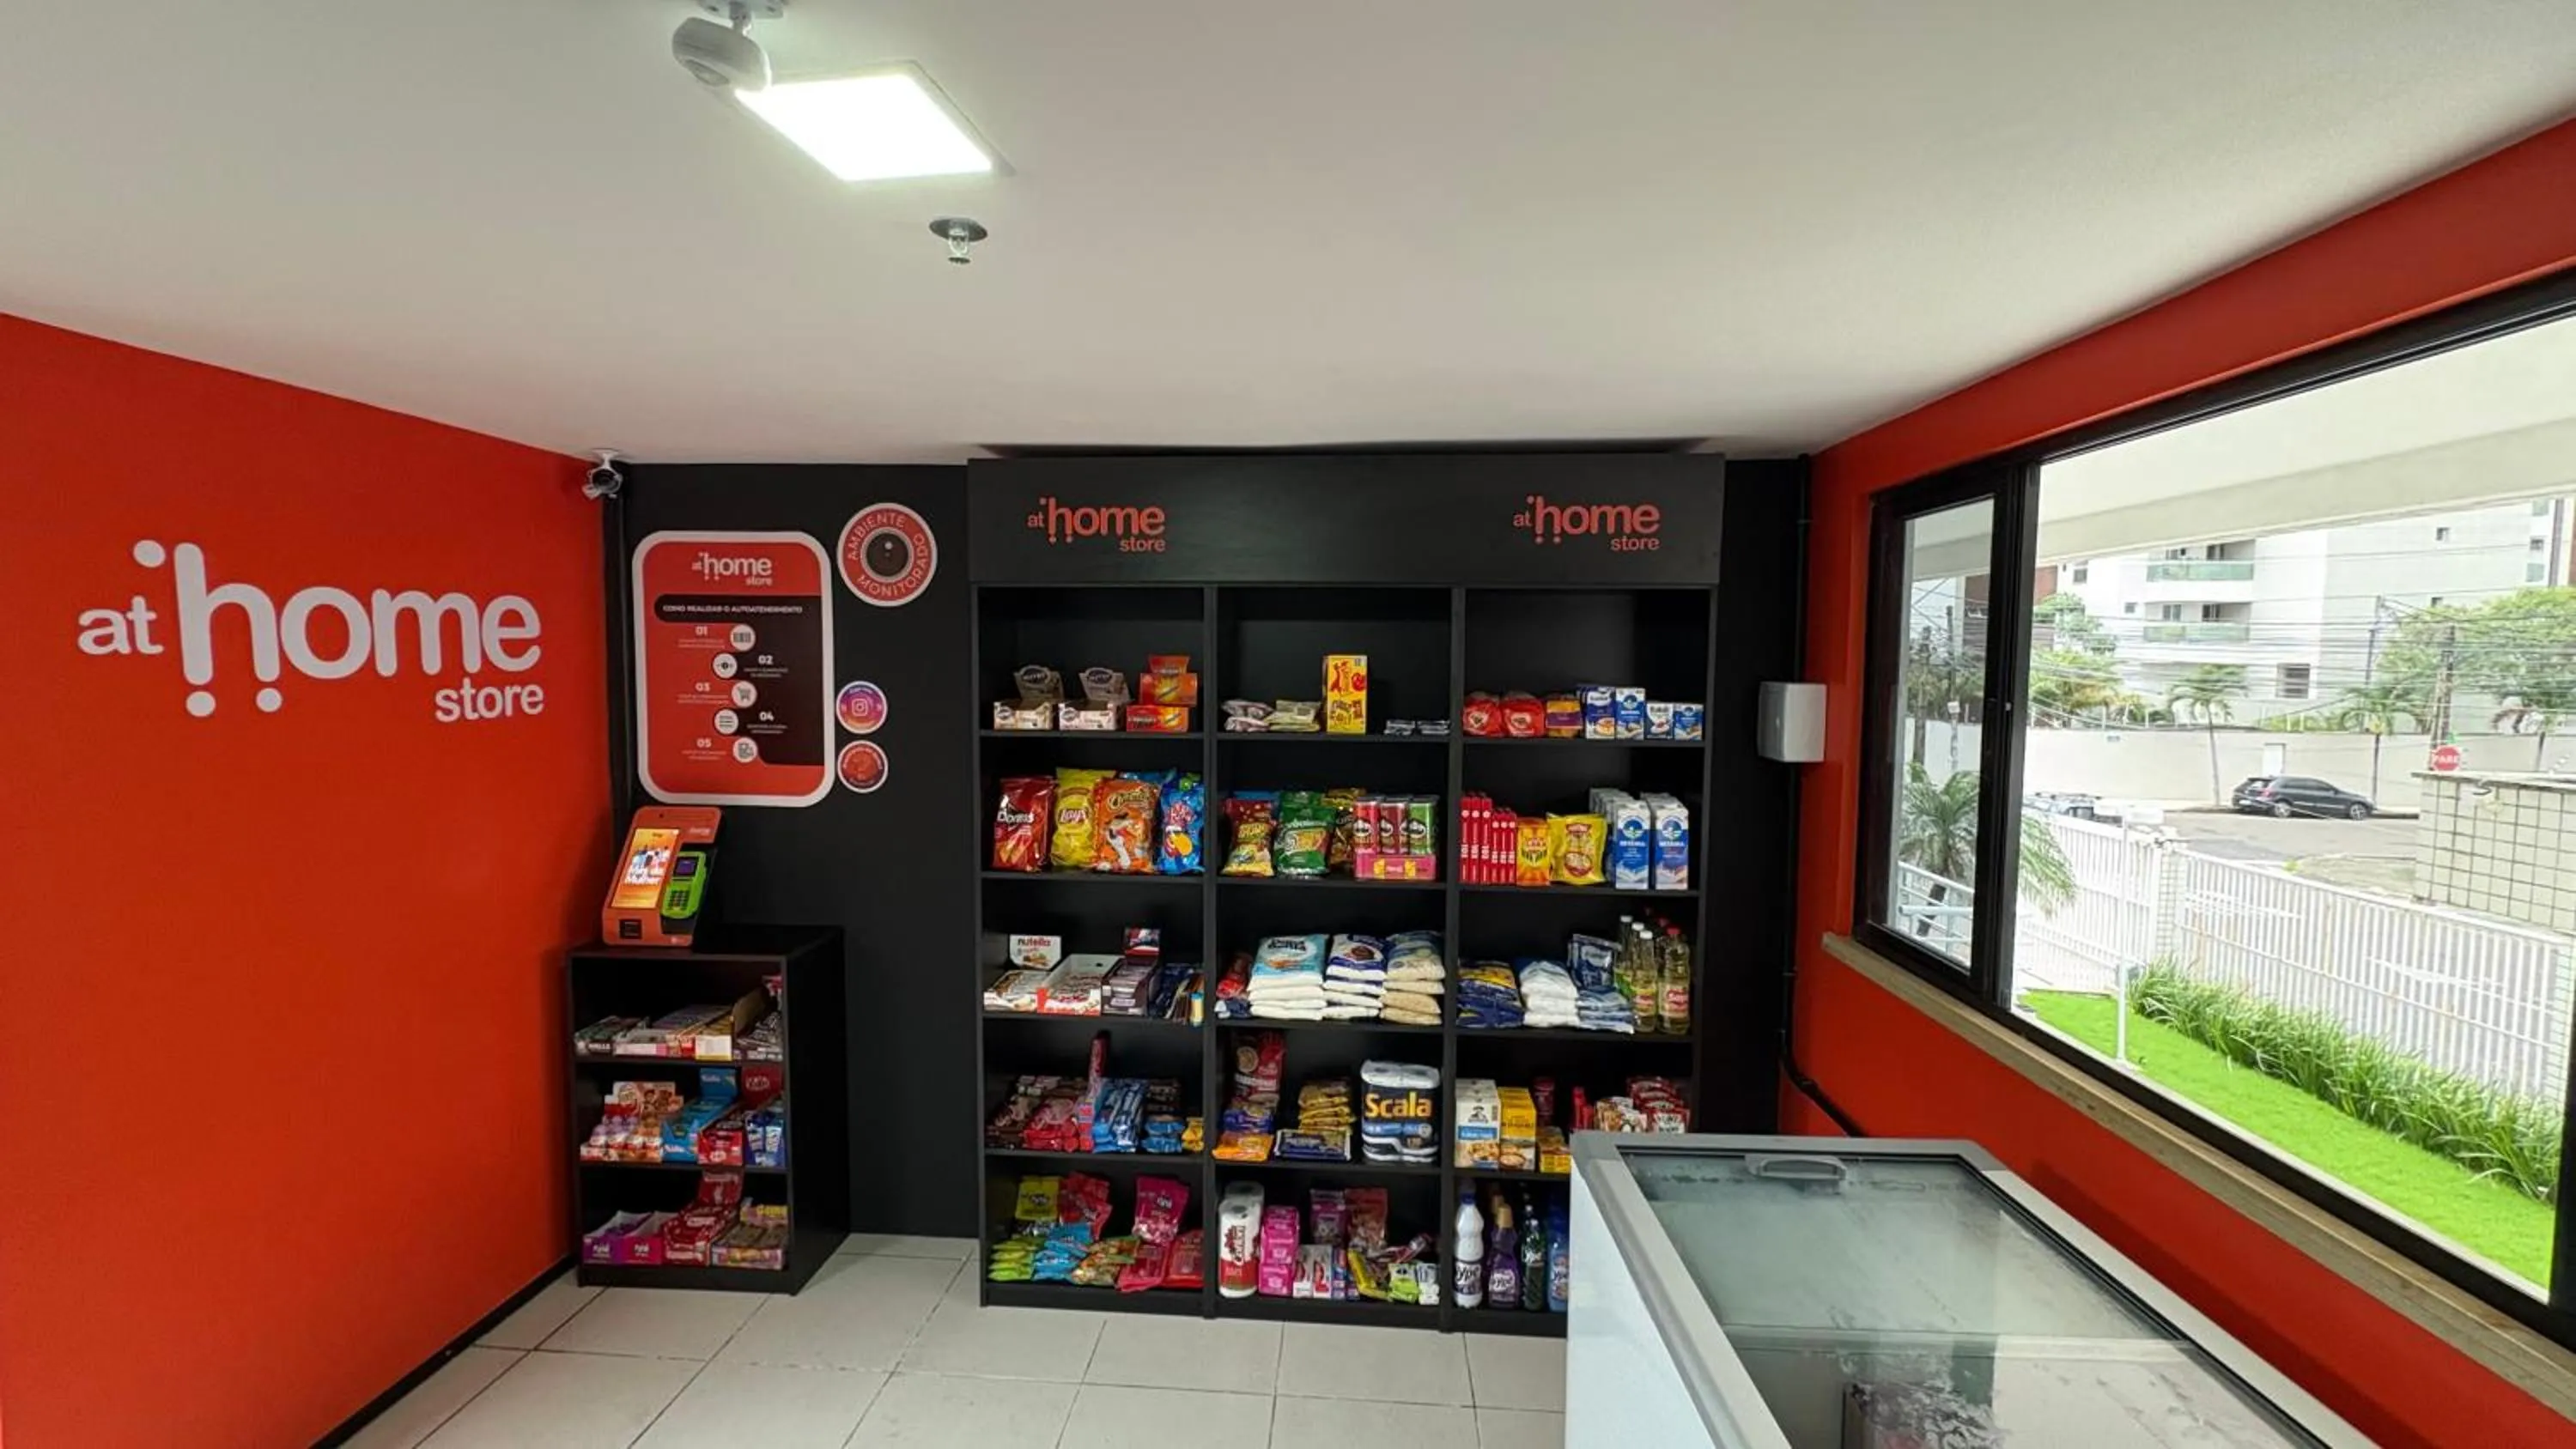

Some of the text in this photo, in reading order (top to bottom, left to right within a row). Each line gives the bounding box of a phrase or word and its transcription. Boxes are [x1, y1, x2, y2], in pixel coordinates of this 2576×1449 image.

[1027, 497, 1165, 537] at home
[1513, 495, 1660, 535] at home
[1120, 537, 1166, 552] store
[1611, 536, 1660, 551] store
[848, 512, 929, 597] AMBIENTE MONITORADO
[703, 551, 772, 577] home
[745, 576, 772, 585] store
[78, 543, 541, 685] at home
[695, 625, 708, 636] 01
[757, 655, 773, 664] 02
[695, 682, 710, 692] 03
[434, 677, 544, 723] store
[759, 711, 775, 721] 04
[696, 738, 712, 748] 05
[1364, 1091, 1432, 1119] Scala
